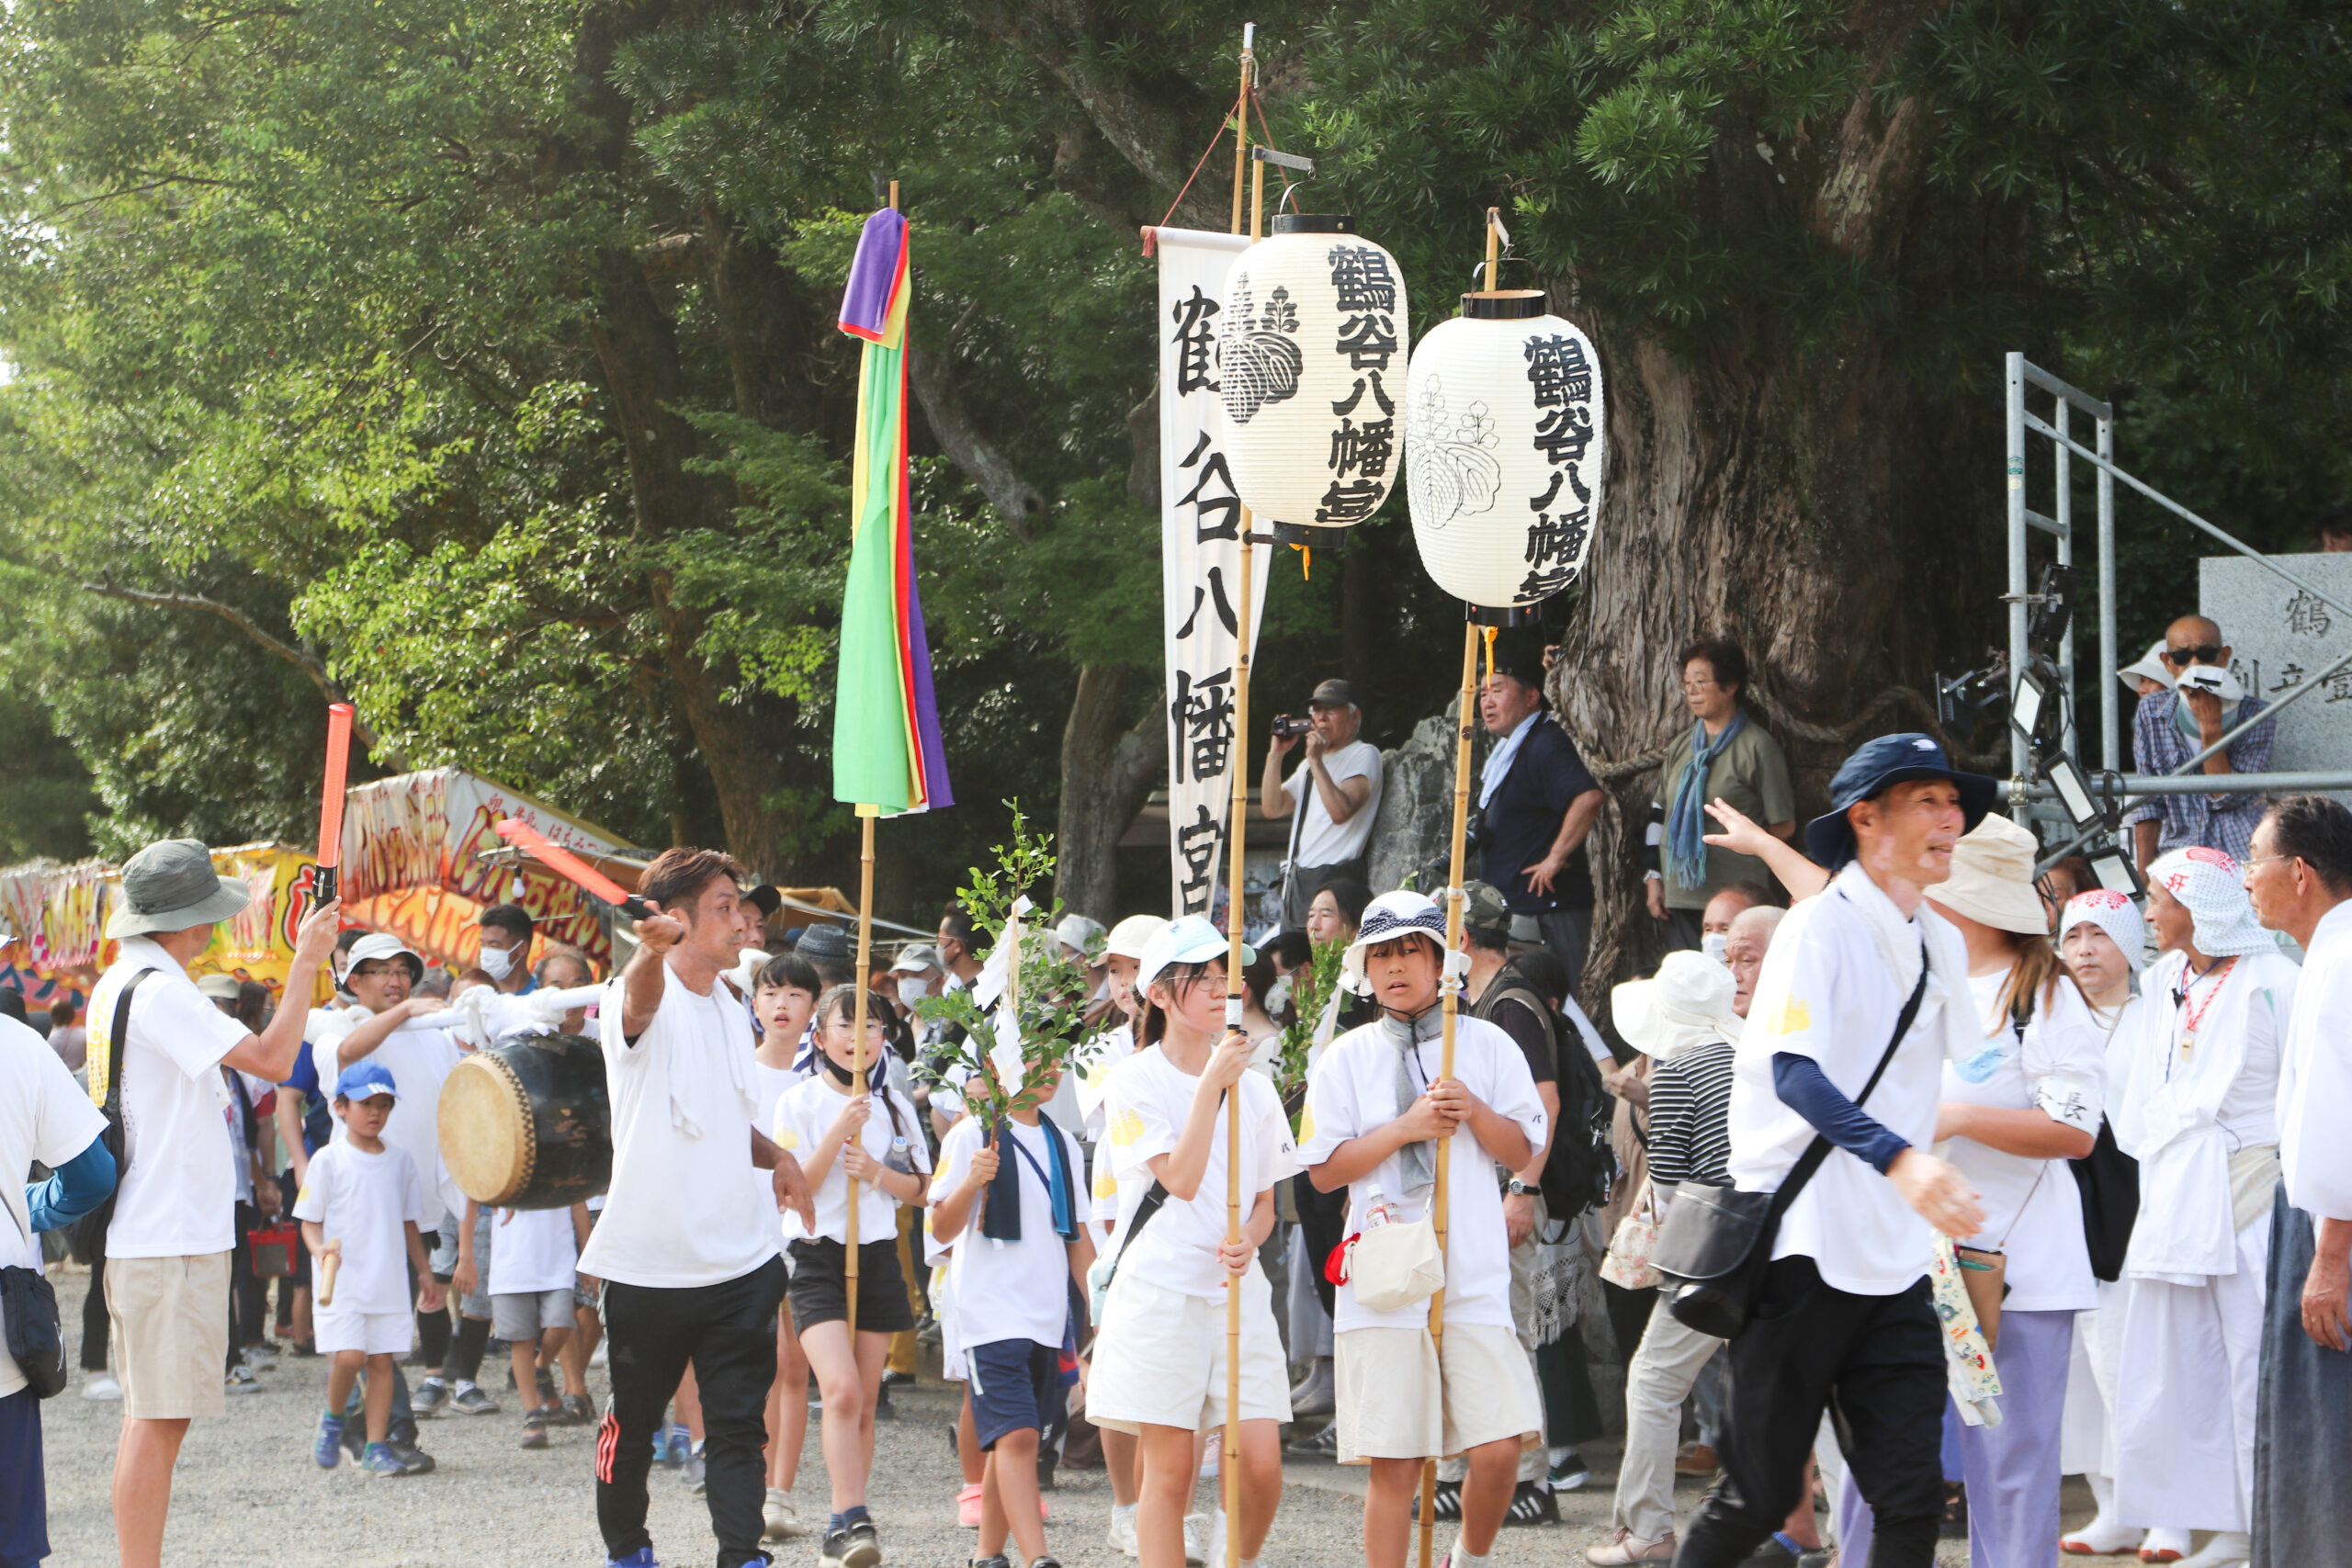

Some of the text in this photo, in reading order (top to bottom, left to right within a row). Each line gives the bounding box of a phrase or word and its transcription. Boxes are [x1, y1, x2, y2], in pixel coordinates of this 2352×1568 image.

[1314, 244, 1397, 523] 鶴谷八幡宮
[1512, 333, 1594, 603] 鶴谷八幡宮
[2283, 589, 2332, 637] 鶴
